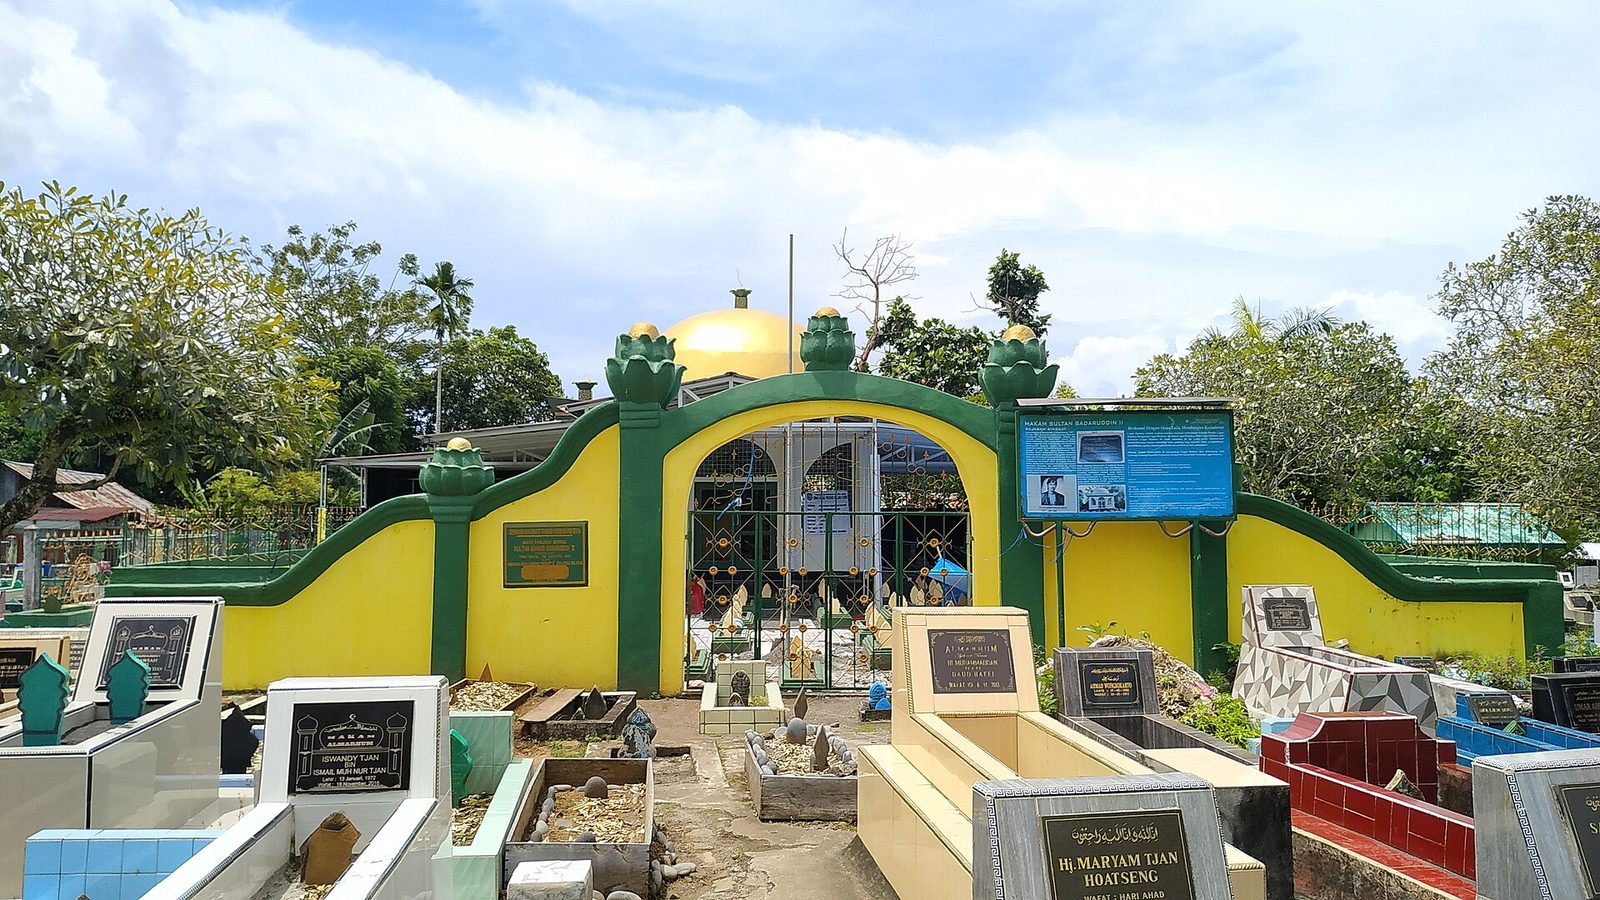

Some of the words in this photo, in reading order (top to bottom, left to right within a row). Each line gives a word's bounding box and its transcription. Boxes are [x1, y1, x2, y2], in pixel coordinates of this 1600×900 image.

[945, 645, 998, 653] ALMARHUM
[322, 755, 358, 763] ISWANDY
[360, 754, 380, 762] TJAN
[1144, 851, 1178, 866] TJAN
[1119, 892, 1140, 900] HARI
[1142, 890, 1166, 900] AHAD
